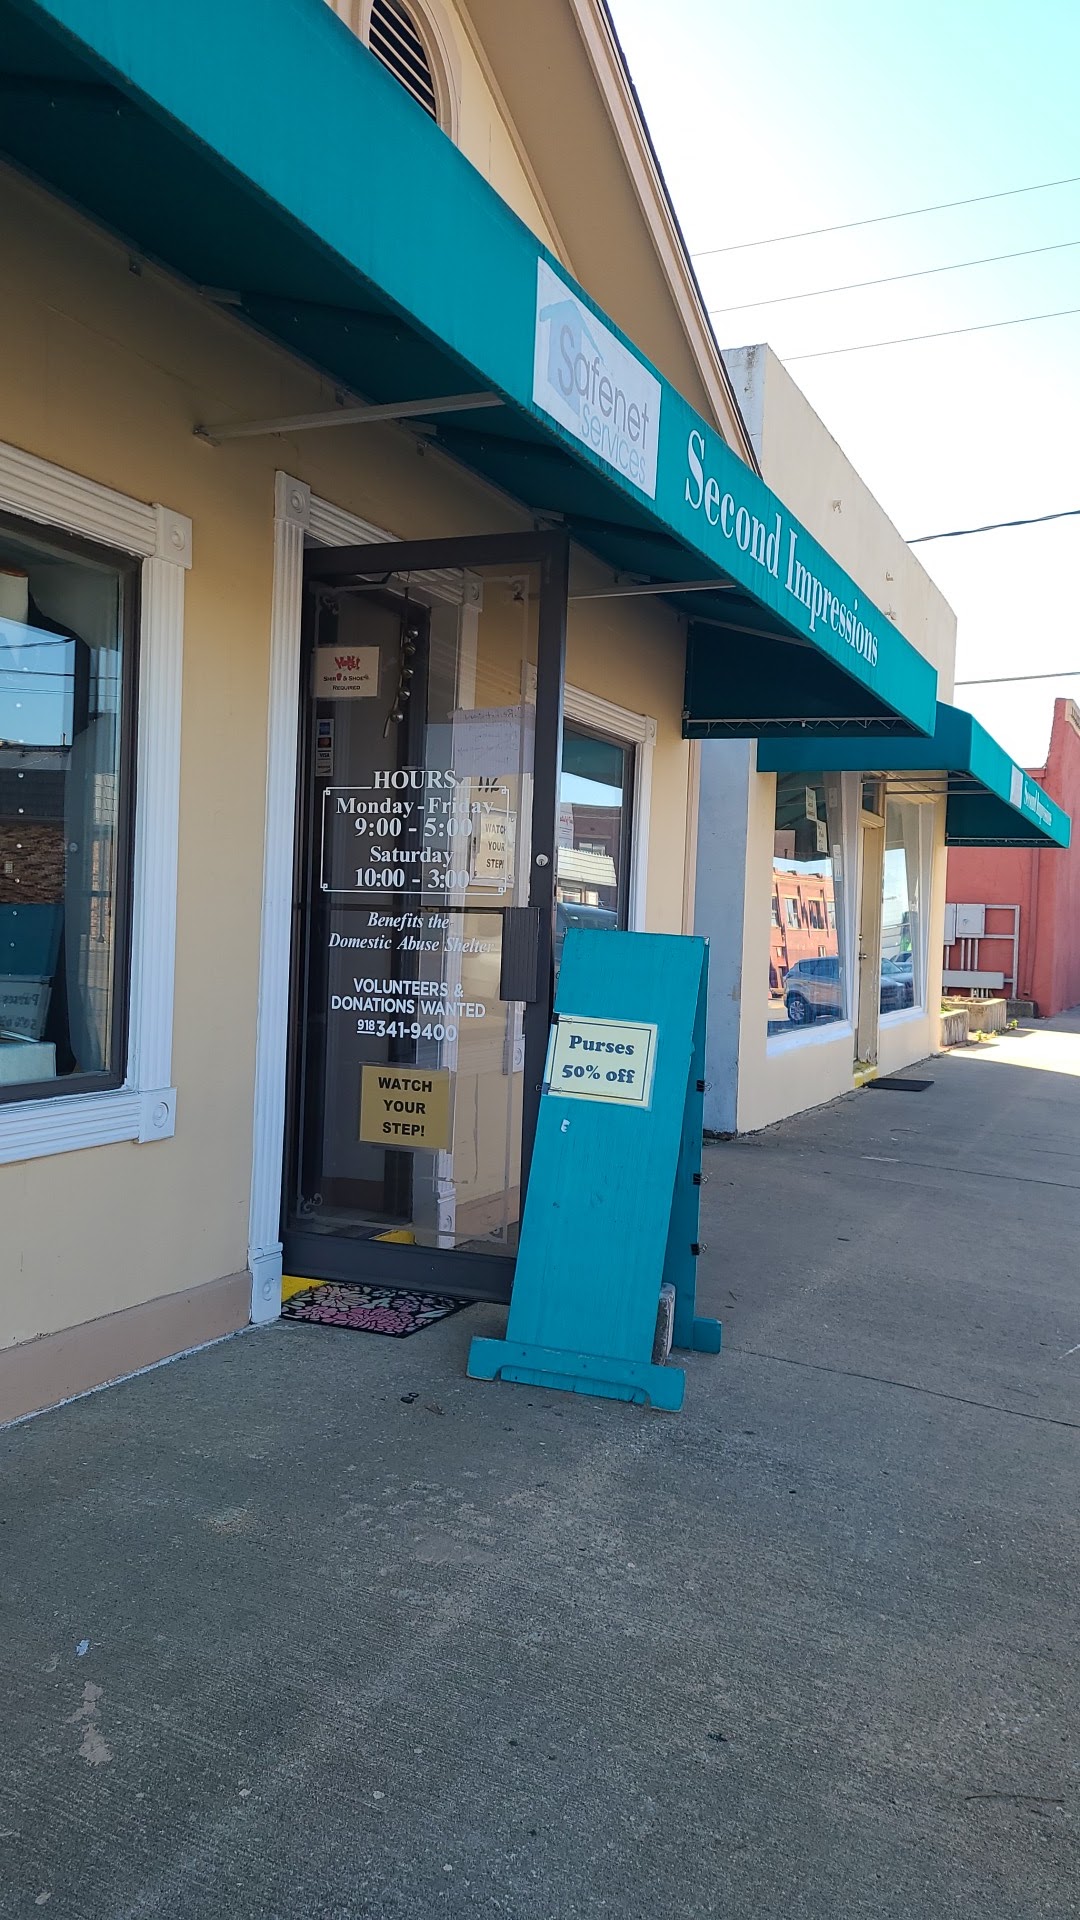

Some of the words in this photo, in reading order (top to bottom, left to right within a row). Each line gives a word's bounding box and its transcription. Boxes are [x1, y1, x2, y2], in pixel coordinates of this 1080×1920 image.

[558, 325, 649, 450] Safenet
[685, 429, 782, 580] Second
[784, 528, 878, 667] Impressions
[373, 770, 456, 789] HOURS
[354, 817, 401, 837] 9:00
[424, 817, 473, 837] 5:00
[370, 845, 453, 867] Saturday
[488, 841, 505, 852] YOUR
[354, 868, 405, 888] 10:00
[427, 869, 470, 889] 3:00
[367, 911, 424, 931] Benefits
[427, 913, 449, 929] the
[328, 932, 392, 949] Domestic
[397, 935, 440, 951] Abuse
[444, 936, 495, 953] Shelter
[353, 977, 449, 997] VOLUNTEERS
[453, 983, 464, 998] &
[331, 996, 415, 1014] DONATIONS
[420, 1000, 486, 1018] WANTED
[568, 1034, 635, 1056] Purses
[378, 1076, 432, 1092] WATCH
[561, 1064, 601, 1080] 50%
[605, 1068, 636, 1084] off
[383, 1099, 426, 1114] YOUR
[382, 1121, 425, 1137] STEP!
